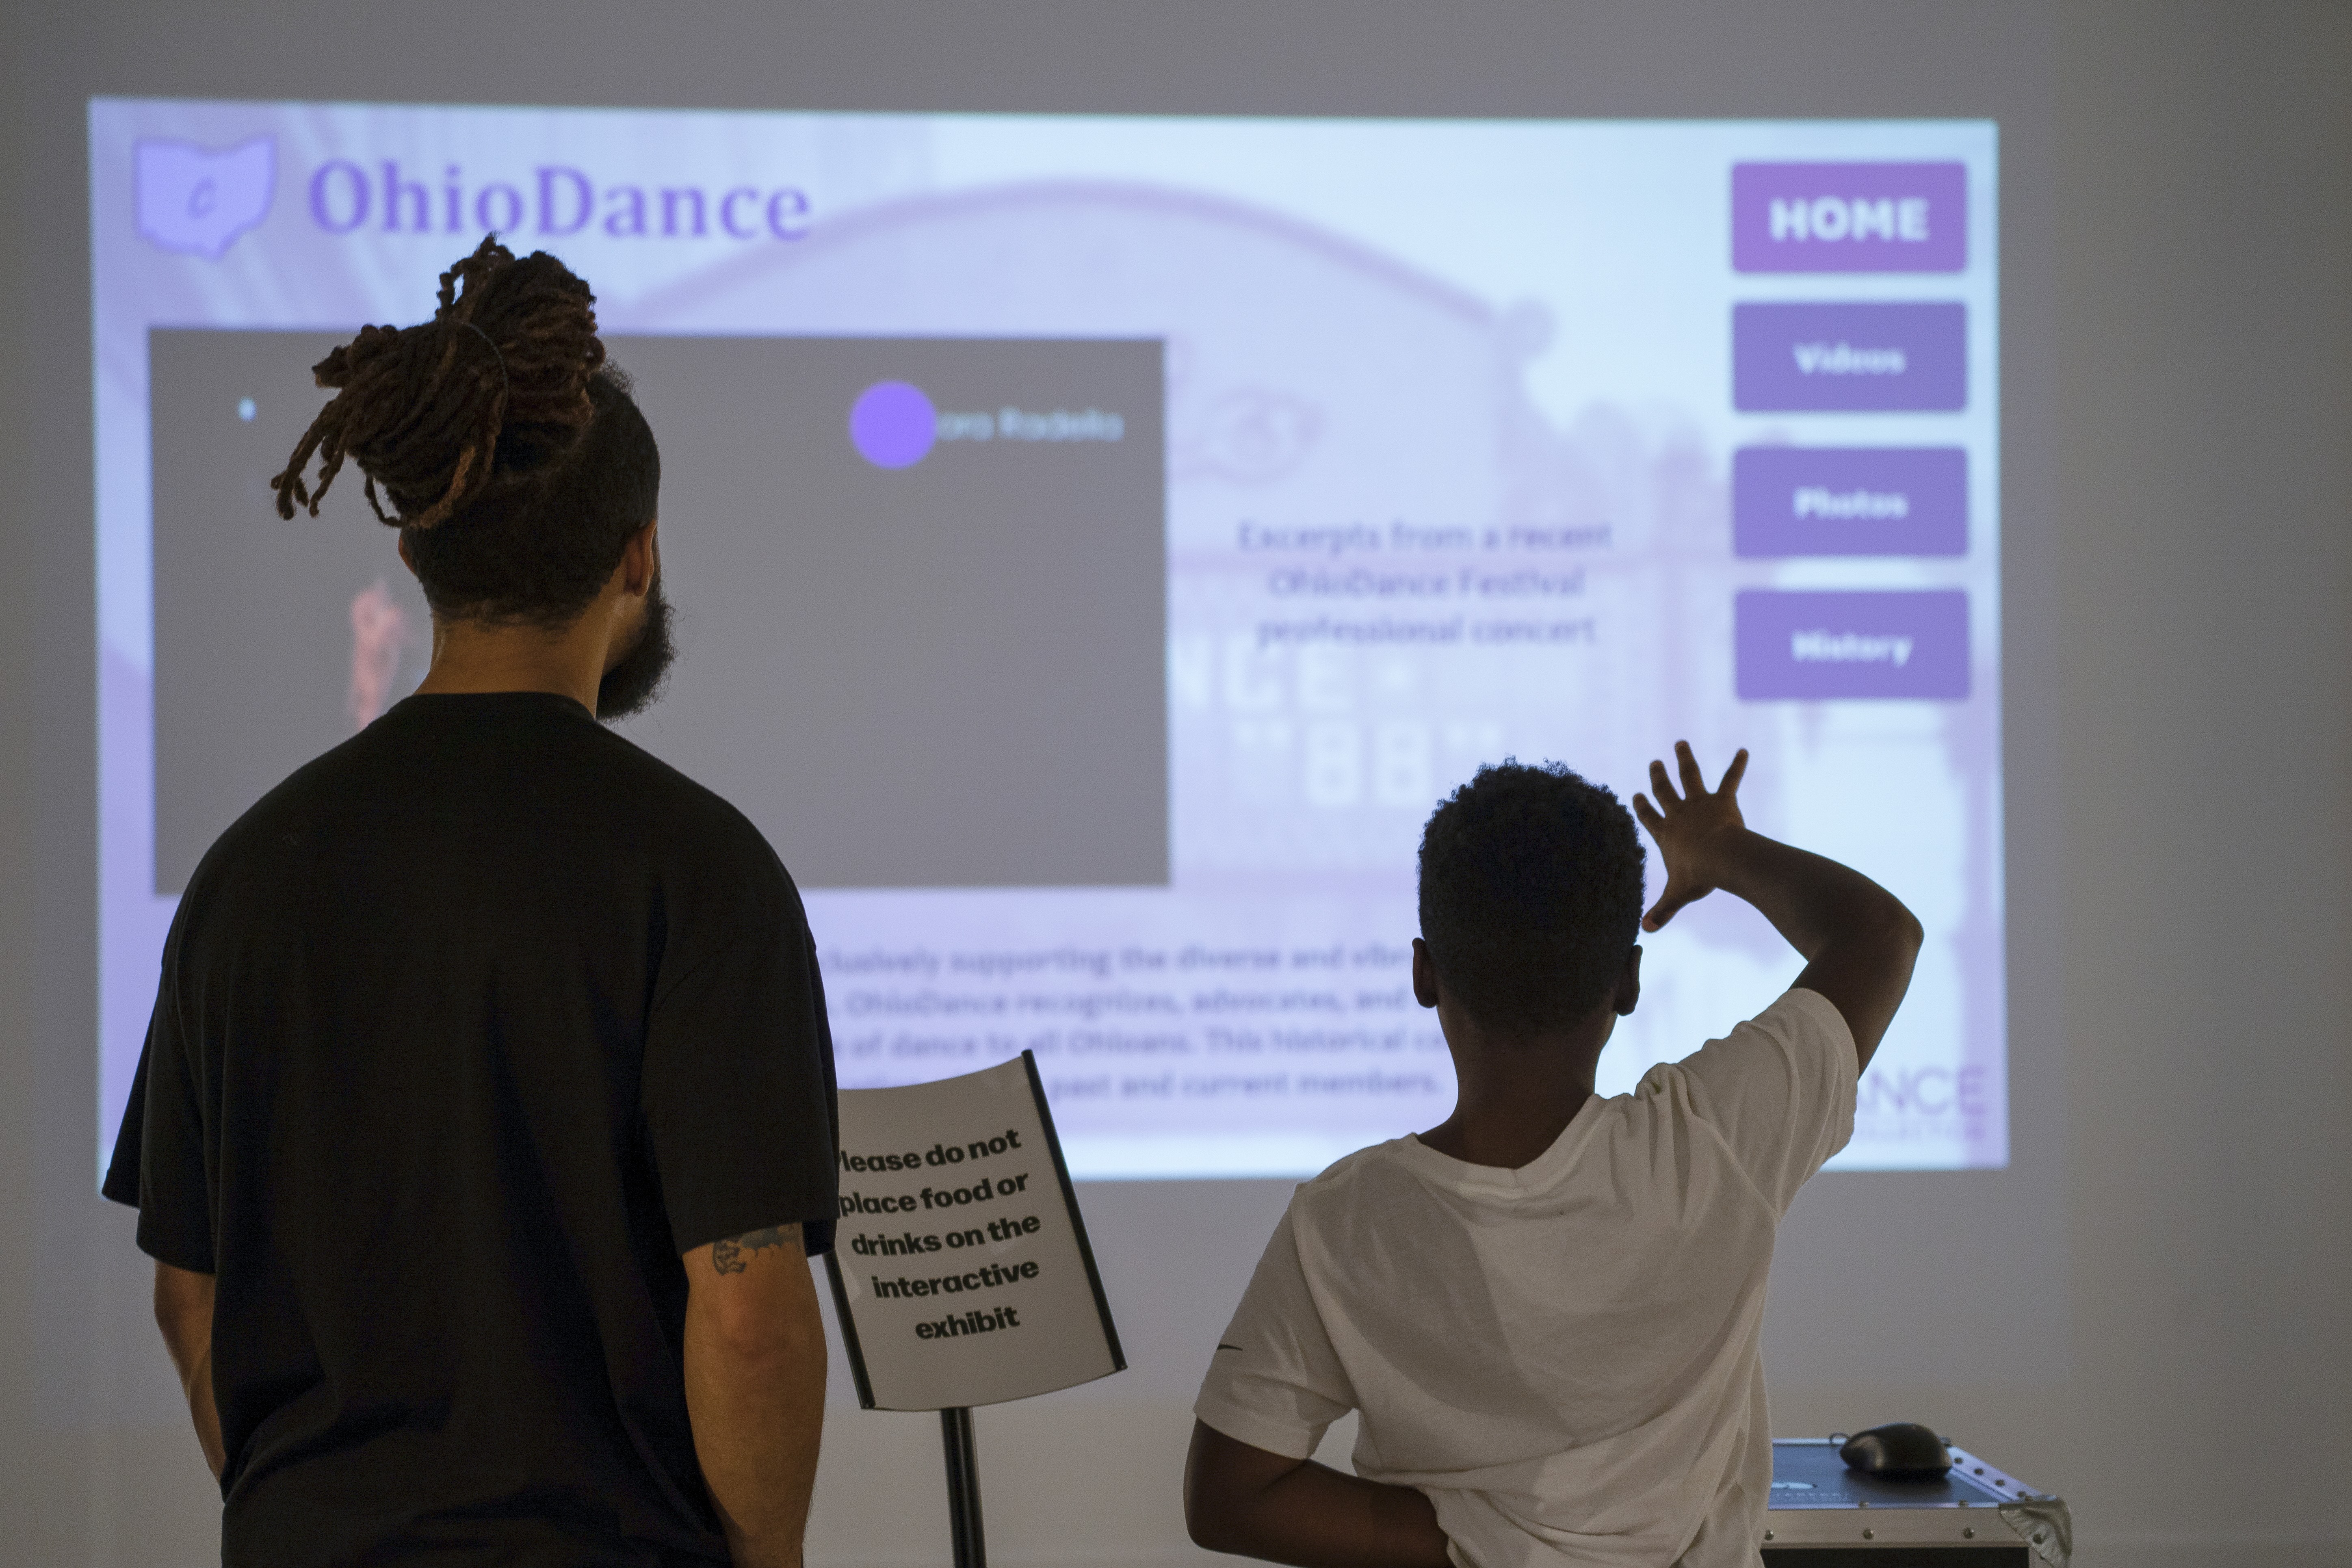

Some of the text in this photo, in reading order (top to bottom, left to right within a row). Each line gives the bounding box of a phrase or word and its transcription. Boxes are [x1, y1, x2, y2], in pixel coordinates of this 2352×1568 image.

[308, 158, 812, 240] OhioDance
[1769, 195, 1930, 242] HOME
[1792, 341, 1908, 375] Videos
[1792, 486, 1910, 519] Photos
[1237, 519, 1613, 560] Excerpts from a recent
[1267, 565, 1586, 598] OhioDance Festival
[1255, 613, 1597, 655] professional concert
[1791, 629, 1912, 667] History
[948, 945, 1112, 981] supporting
[1118, 945, 1168, 972] the
[1175, 943, 1283, 972] diverse
[1289, 942, 1344, 971] and
[839, 1128, 1022, 1172] lease do not
[840, 1172, 1029, 1217] place food or
[851, 1215, 1041, 1256] drinks on the
[871, 1260, 1040, 1298] interactive
[915, 1306, 1020, 1340] exhibit
